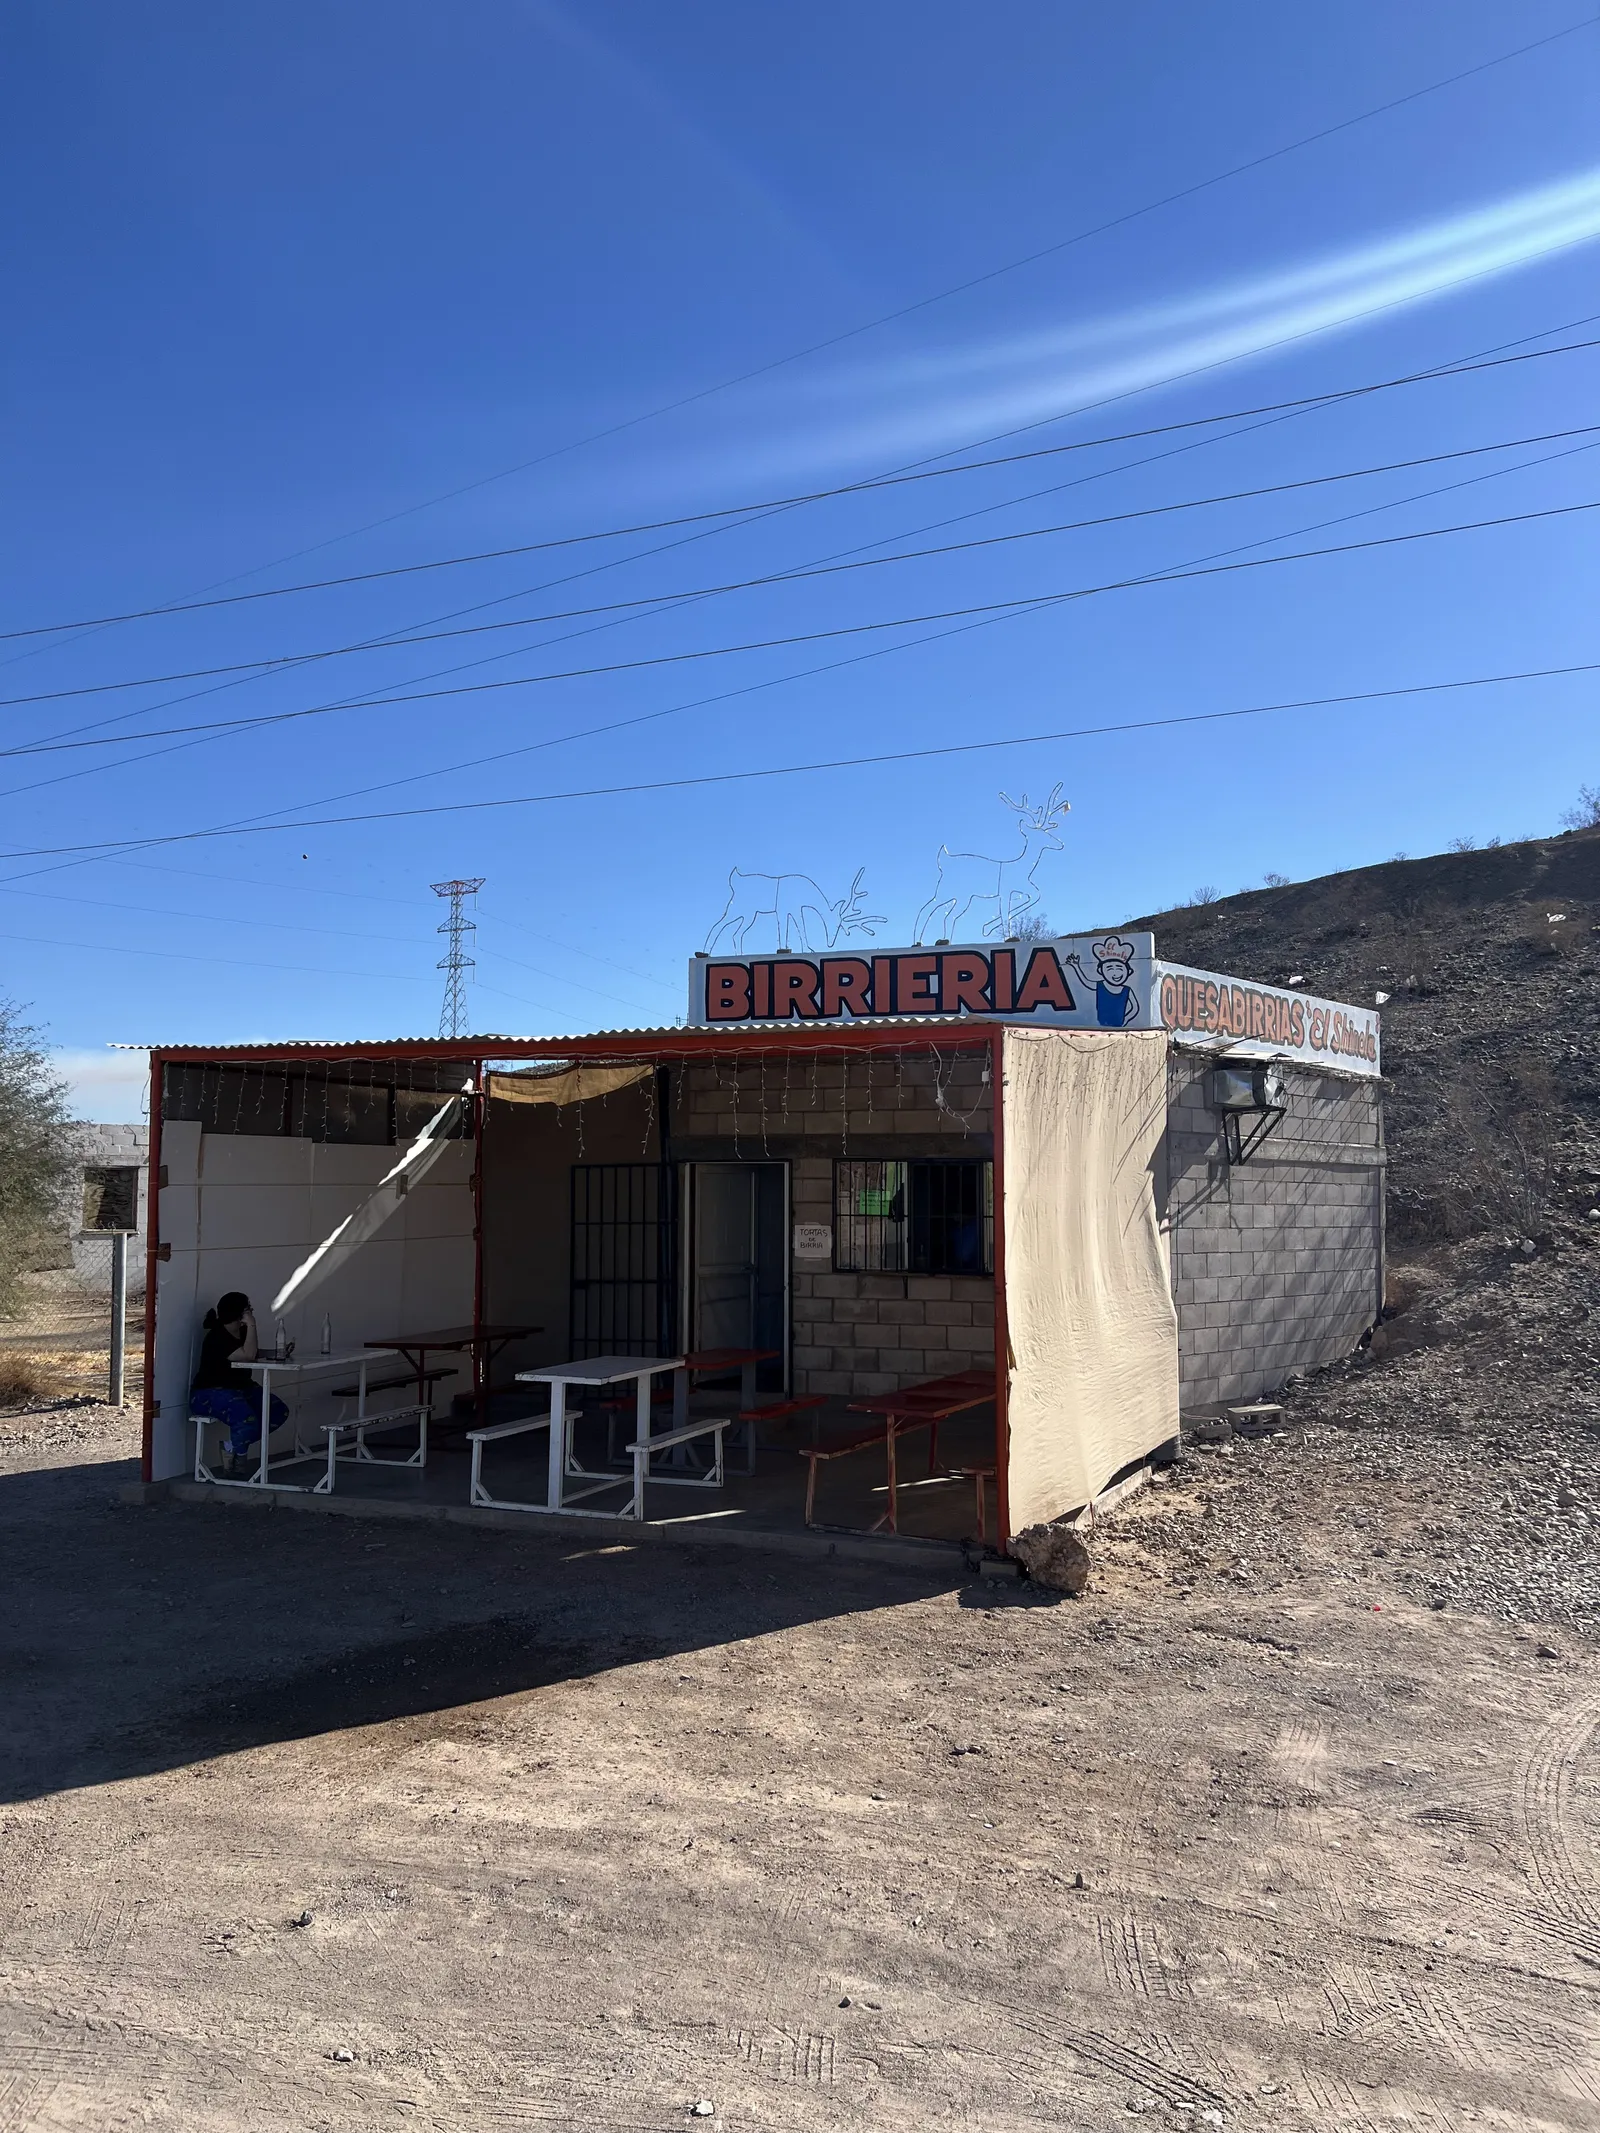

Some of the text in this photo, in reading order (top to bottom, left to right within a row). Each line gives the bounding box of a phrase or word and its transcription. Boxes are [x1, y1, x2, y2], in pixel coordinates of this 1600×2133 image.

[705, 947, 1076, 1022] BIRRIERIA
[1160, 973, 1305, 1048] QUESABIRRIAS
[800, 1228, 828, 1237] TORTAS
